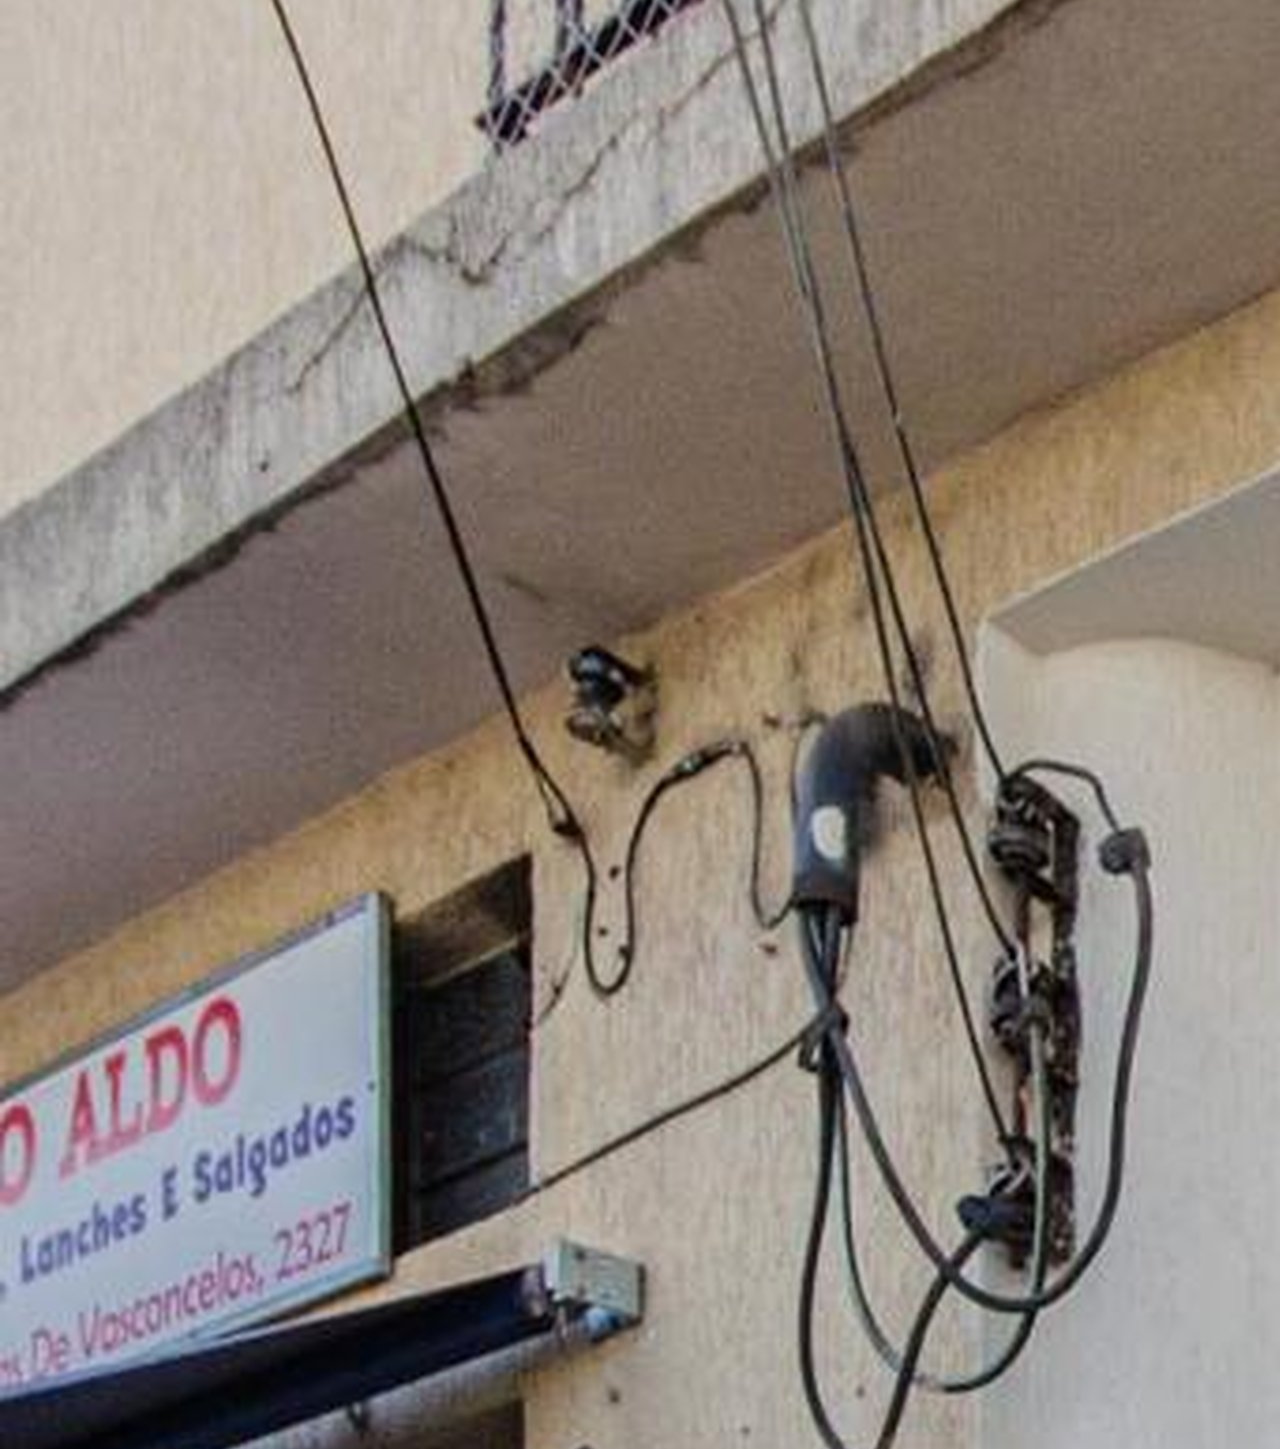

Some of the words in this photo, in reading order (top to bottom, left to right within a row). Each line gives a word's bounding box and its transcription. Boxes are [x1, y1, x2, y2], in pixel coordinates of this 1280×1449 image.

[58, 993, 242, 1181] ALDO
[20, 1193, 147, 1282] Lanches
[162, 1166, 179, 1221] E
[193, 1096, 356, 1203] Salgados
[30, 1324, 70, 1374] De
[276, 1200, 353, 1281] 2327
